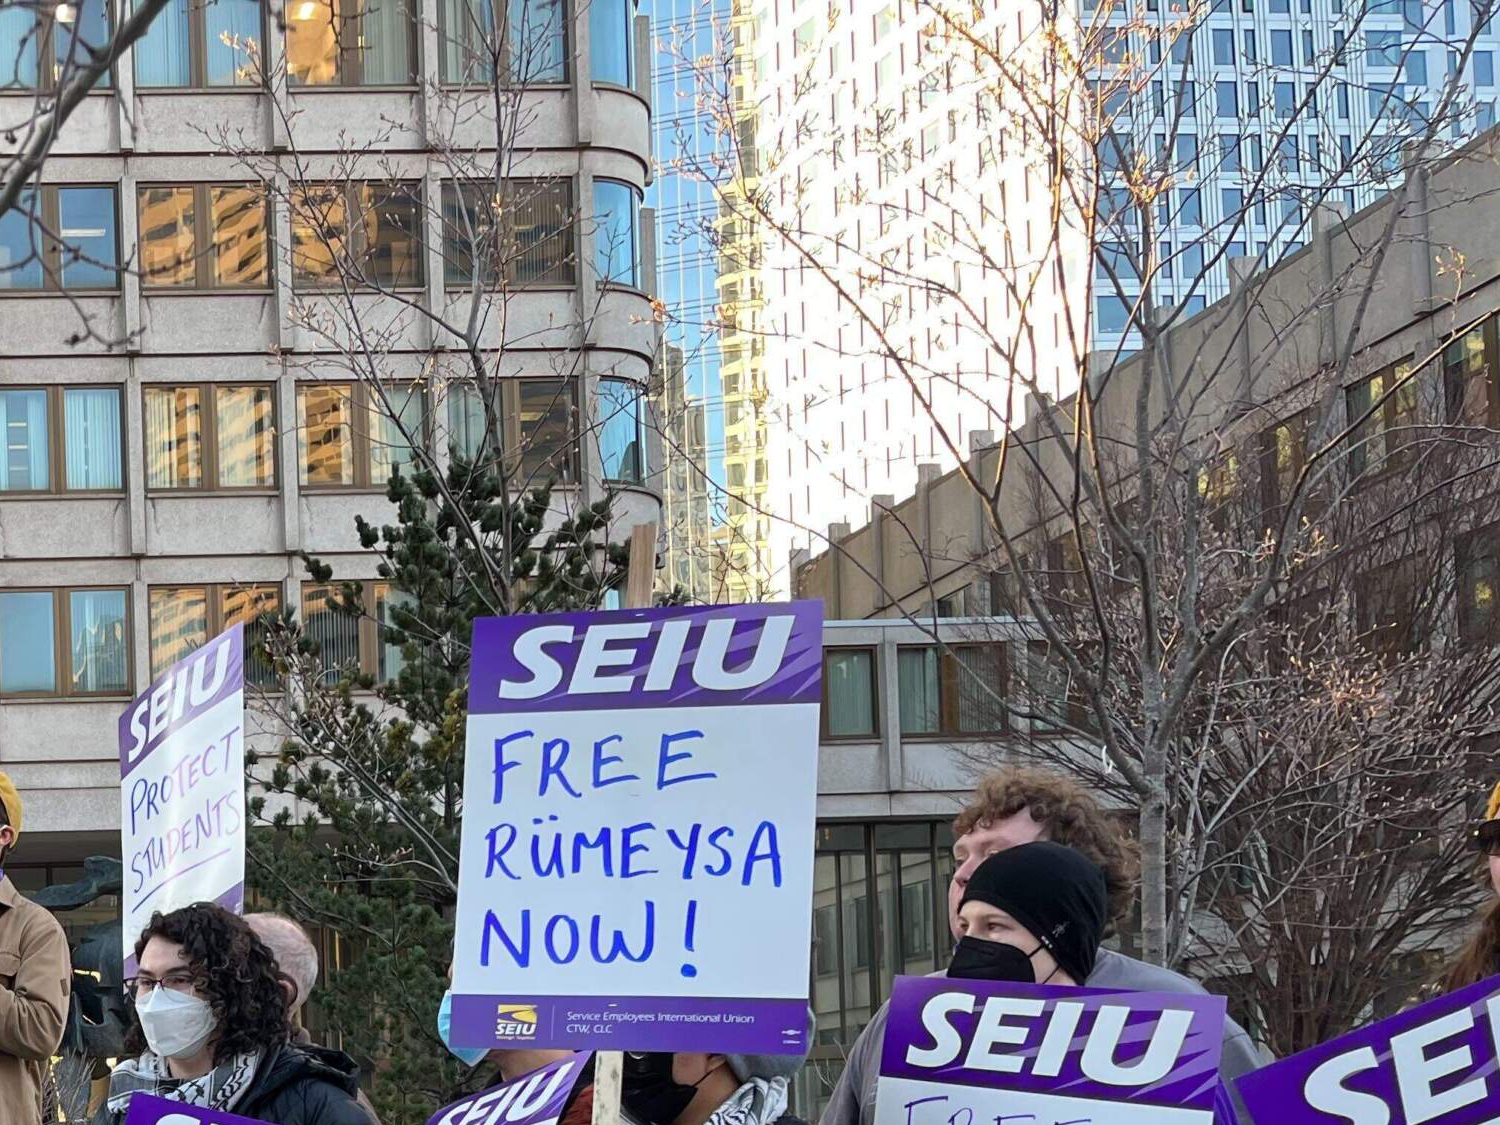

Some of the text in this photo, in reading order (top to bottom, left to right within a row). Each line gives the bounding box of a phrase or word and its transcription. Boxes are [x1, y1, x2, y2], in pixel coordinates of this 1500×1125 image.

[499, 615, 796, 699] SEIU
[128, 638, 231, 763] SEIU
[131, 727, 240, 834] PROTECT
[493, 730, 717, 804] FREE
[132, 790, 240, 893] STUDENTS
[484, 814, 782, 887] RÜMEYSA
[495, 1023, 536, 1035] SEIU
[567, 1012, 754, 1024] Service Employees International Union
[593, 1025, 612, 1034] CLC
[905, 992, 1195, 1086] SEIU
